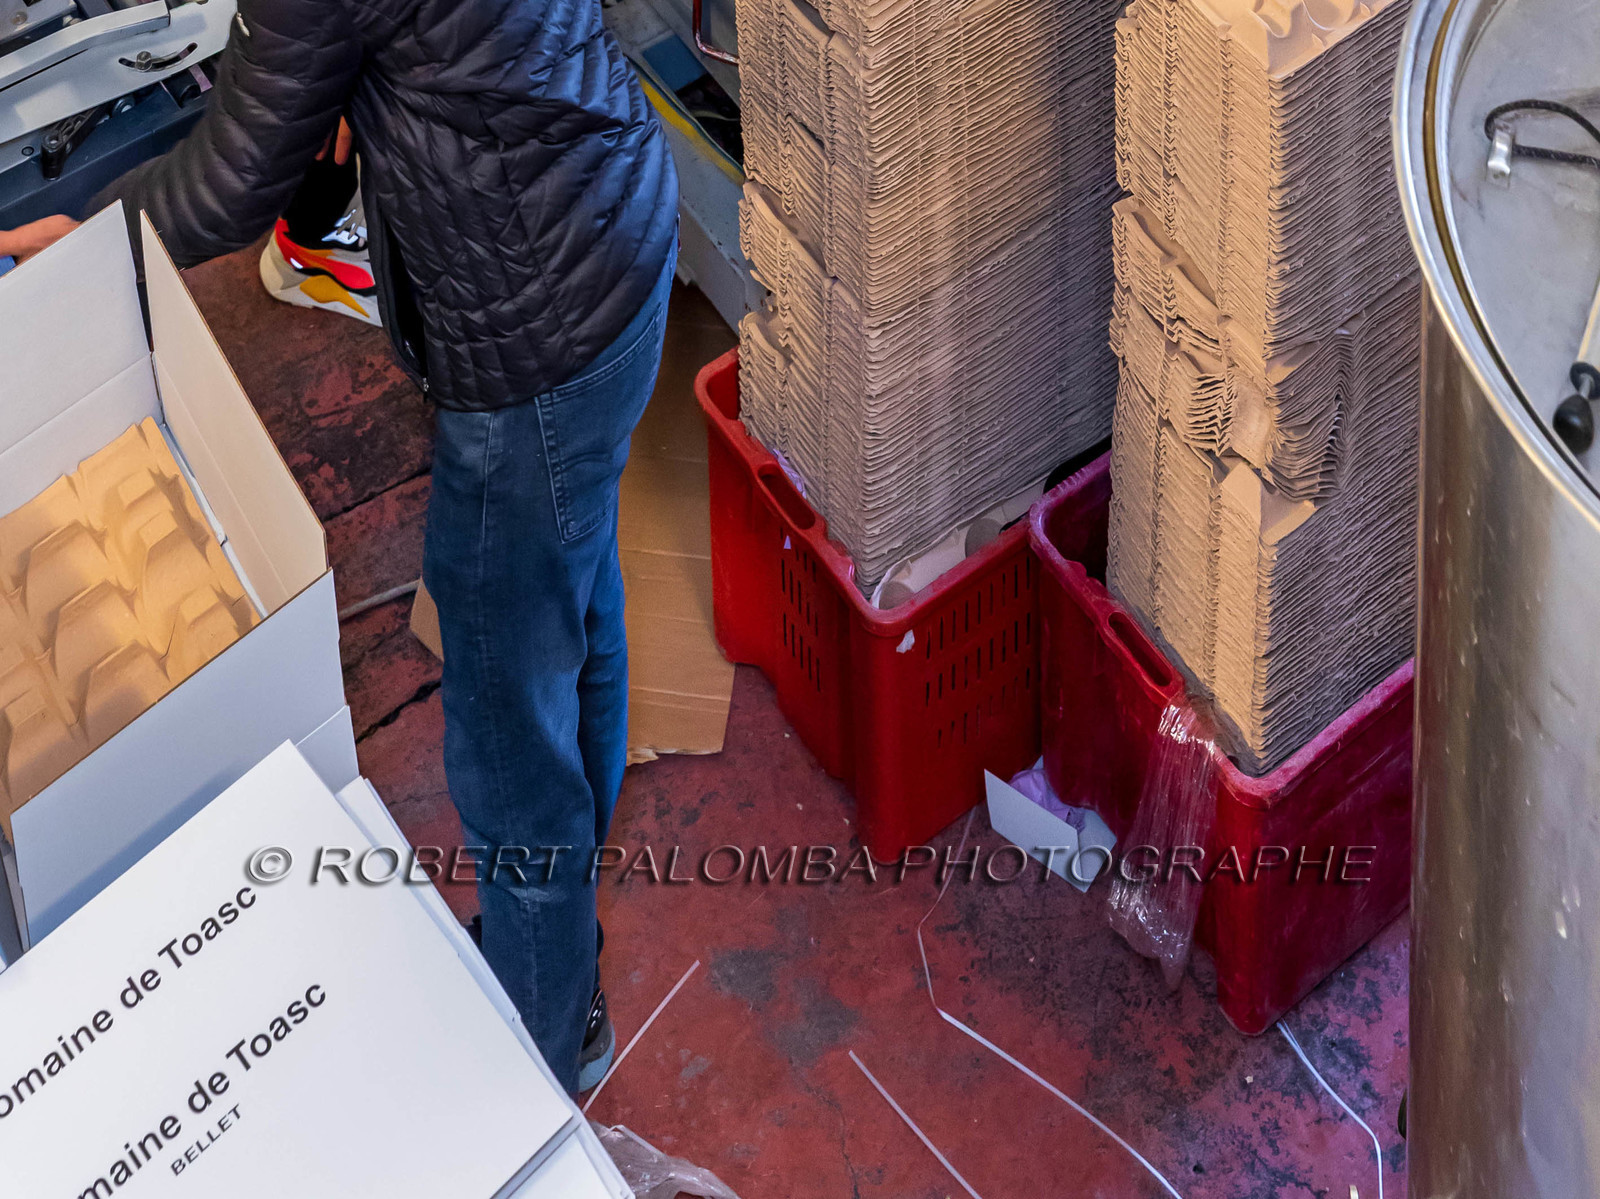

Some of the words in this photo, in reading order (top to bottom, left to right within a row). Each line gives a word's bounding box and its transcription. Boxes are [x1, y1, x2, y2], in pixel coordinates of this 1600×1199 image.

[120, 969, 162, 1009] de
[158, 886, 257, 969] Toasc
[187, 1070, 231, 1114] de
[225, 983, 327, 1073] Toasc
[170, 1103, 243, 1176] BELLET
